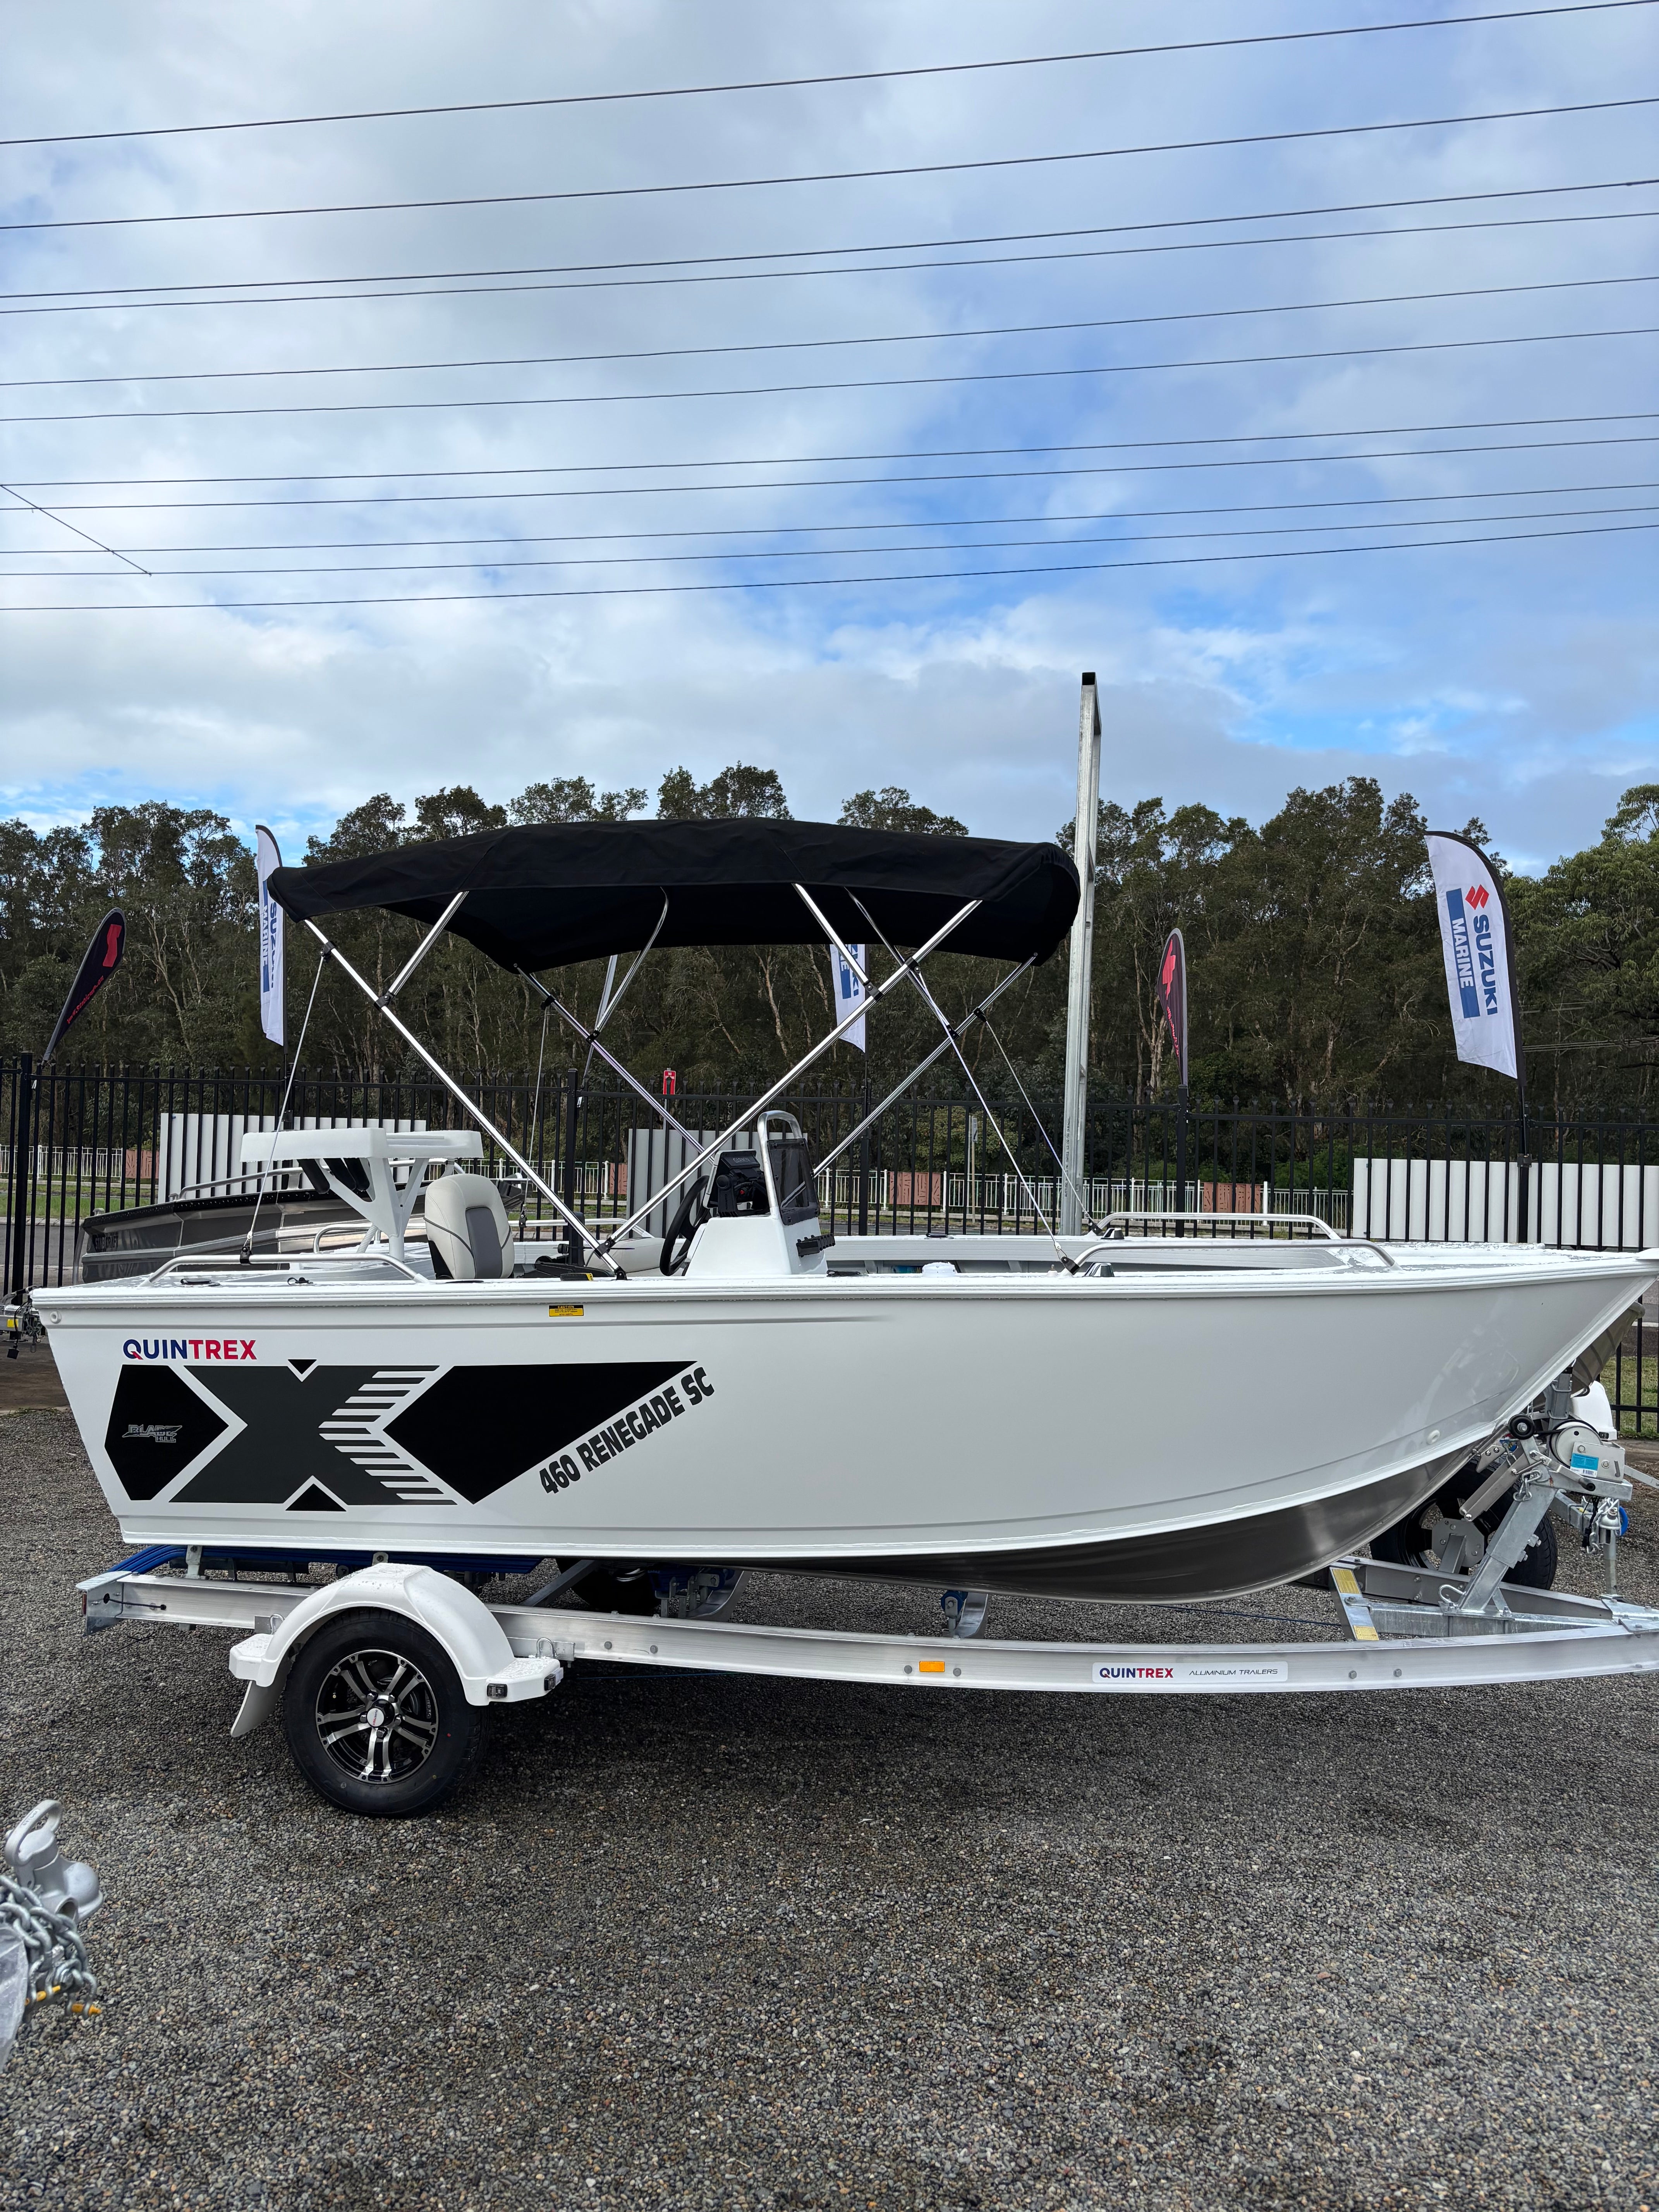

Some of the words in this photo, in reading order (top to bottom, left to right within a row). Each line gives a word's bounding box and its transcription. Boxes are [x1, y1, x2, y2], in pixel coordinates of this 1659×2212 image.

[1452, 918, 1474, 988] MARINE
[1474, 914, 1498, 1015] SUZUKI
[123, 1339, 257, 1360] QUINTREX
[125, 1425, 180, 1437] BLADE
[539, 1454, 581, 1494] 460
[576, 1386, 685, 1472] RENEGADE
[681, 1367, 715, 1406] SC
[1099, 1668, 1174, 1678] QUINTREX
